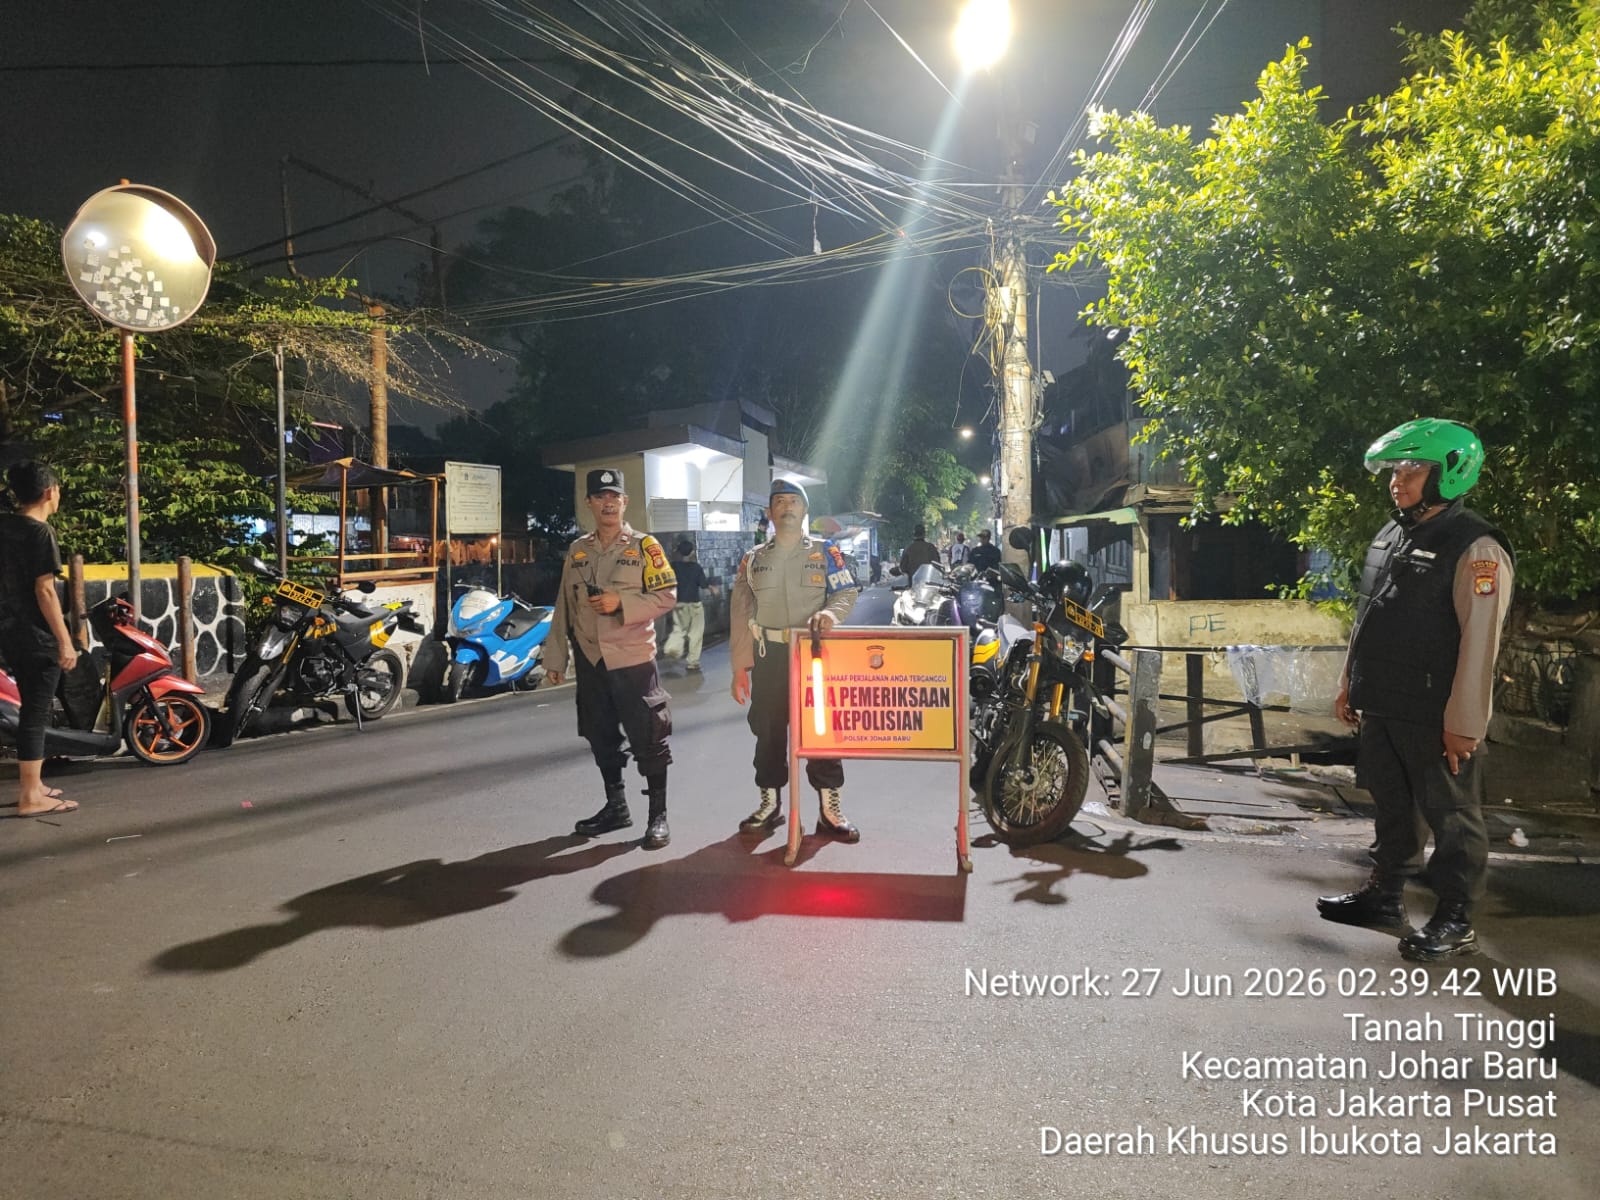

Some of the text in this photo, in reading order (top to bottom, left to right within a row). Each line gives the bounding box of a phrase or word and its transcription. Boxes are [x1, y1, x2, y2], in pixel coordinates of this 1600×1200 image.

[830, 674, 848, 682] MAAF
[849, 674, 889, 682] PERJALANAN
[890, 674, 908, 682] ANDA
[909, 674, 947, 683] TERGANGGU
[805, 686, 950, 707] AA PEMERIKSAAN
[832, 710, 923, 731] KEPOLISIAN
